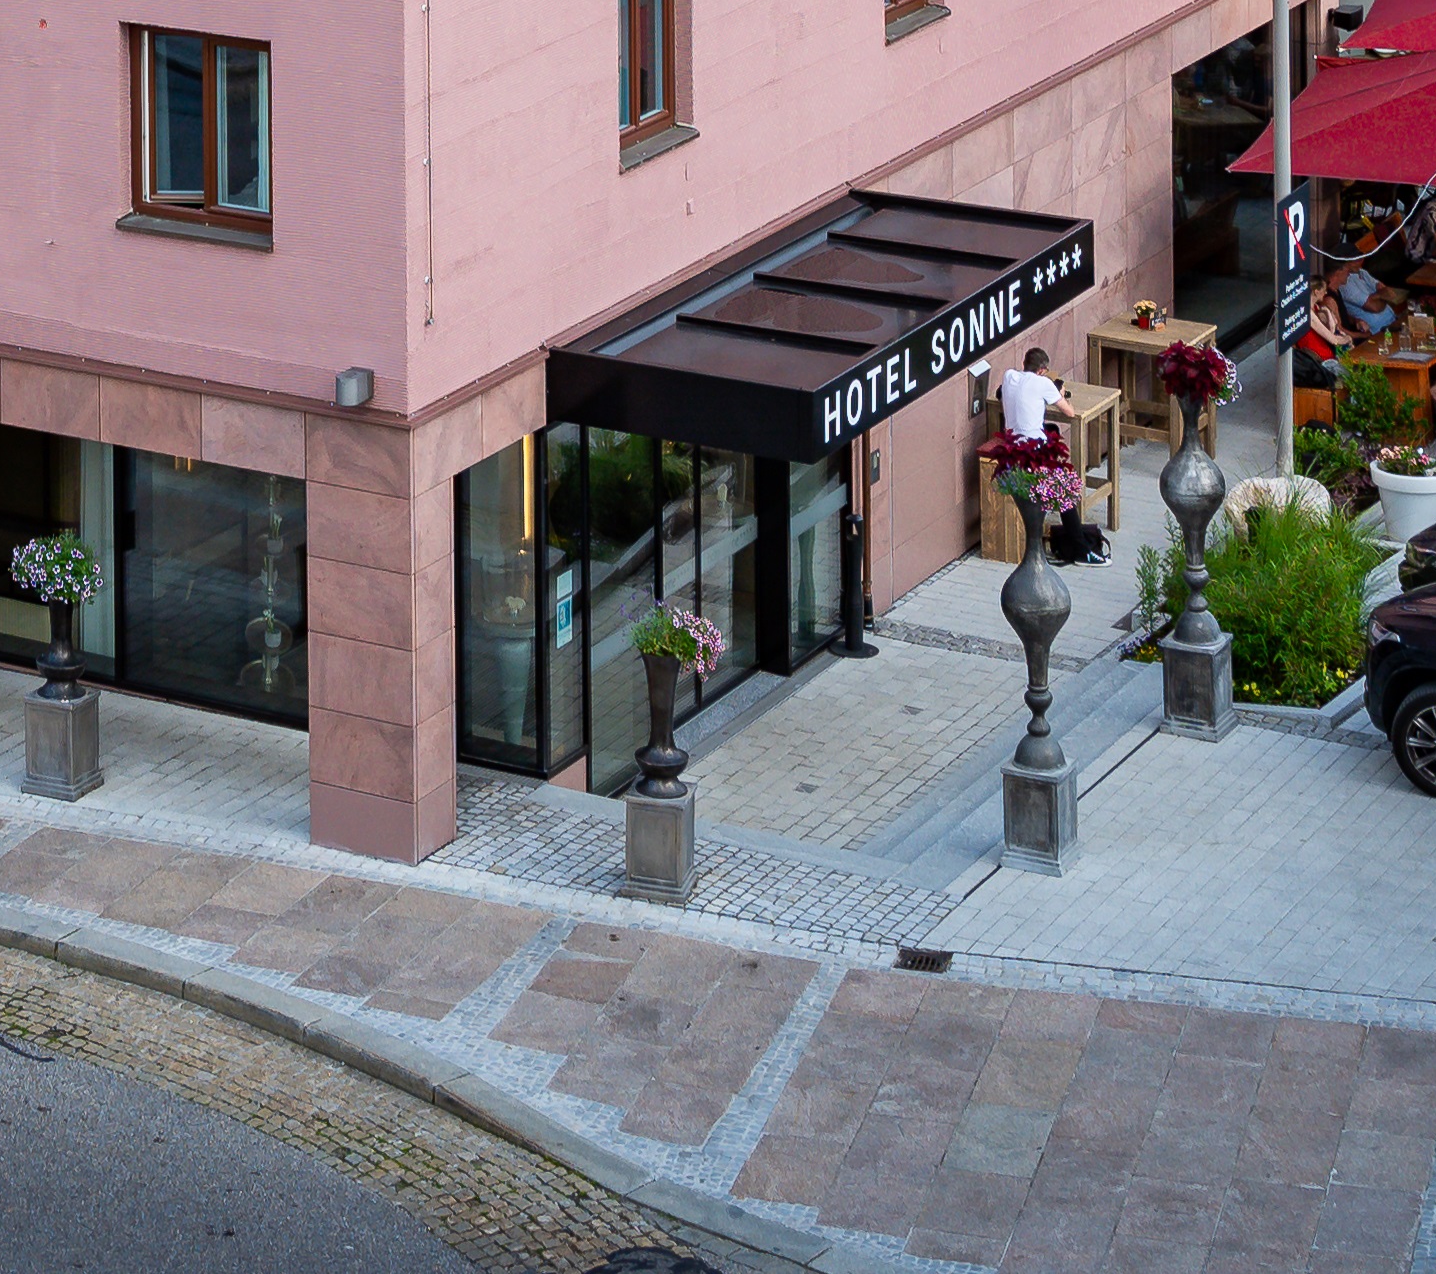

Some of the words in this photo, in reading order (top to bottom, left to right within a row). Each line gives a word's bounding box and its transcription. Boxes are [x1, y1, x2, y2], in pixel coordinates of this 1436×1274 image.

[1288, 200, 1305, 271] P
[824, 347, 917, 443] HOTEL
[931, 279, 1021, 374] SONNE
